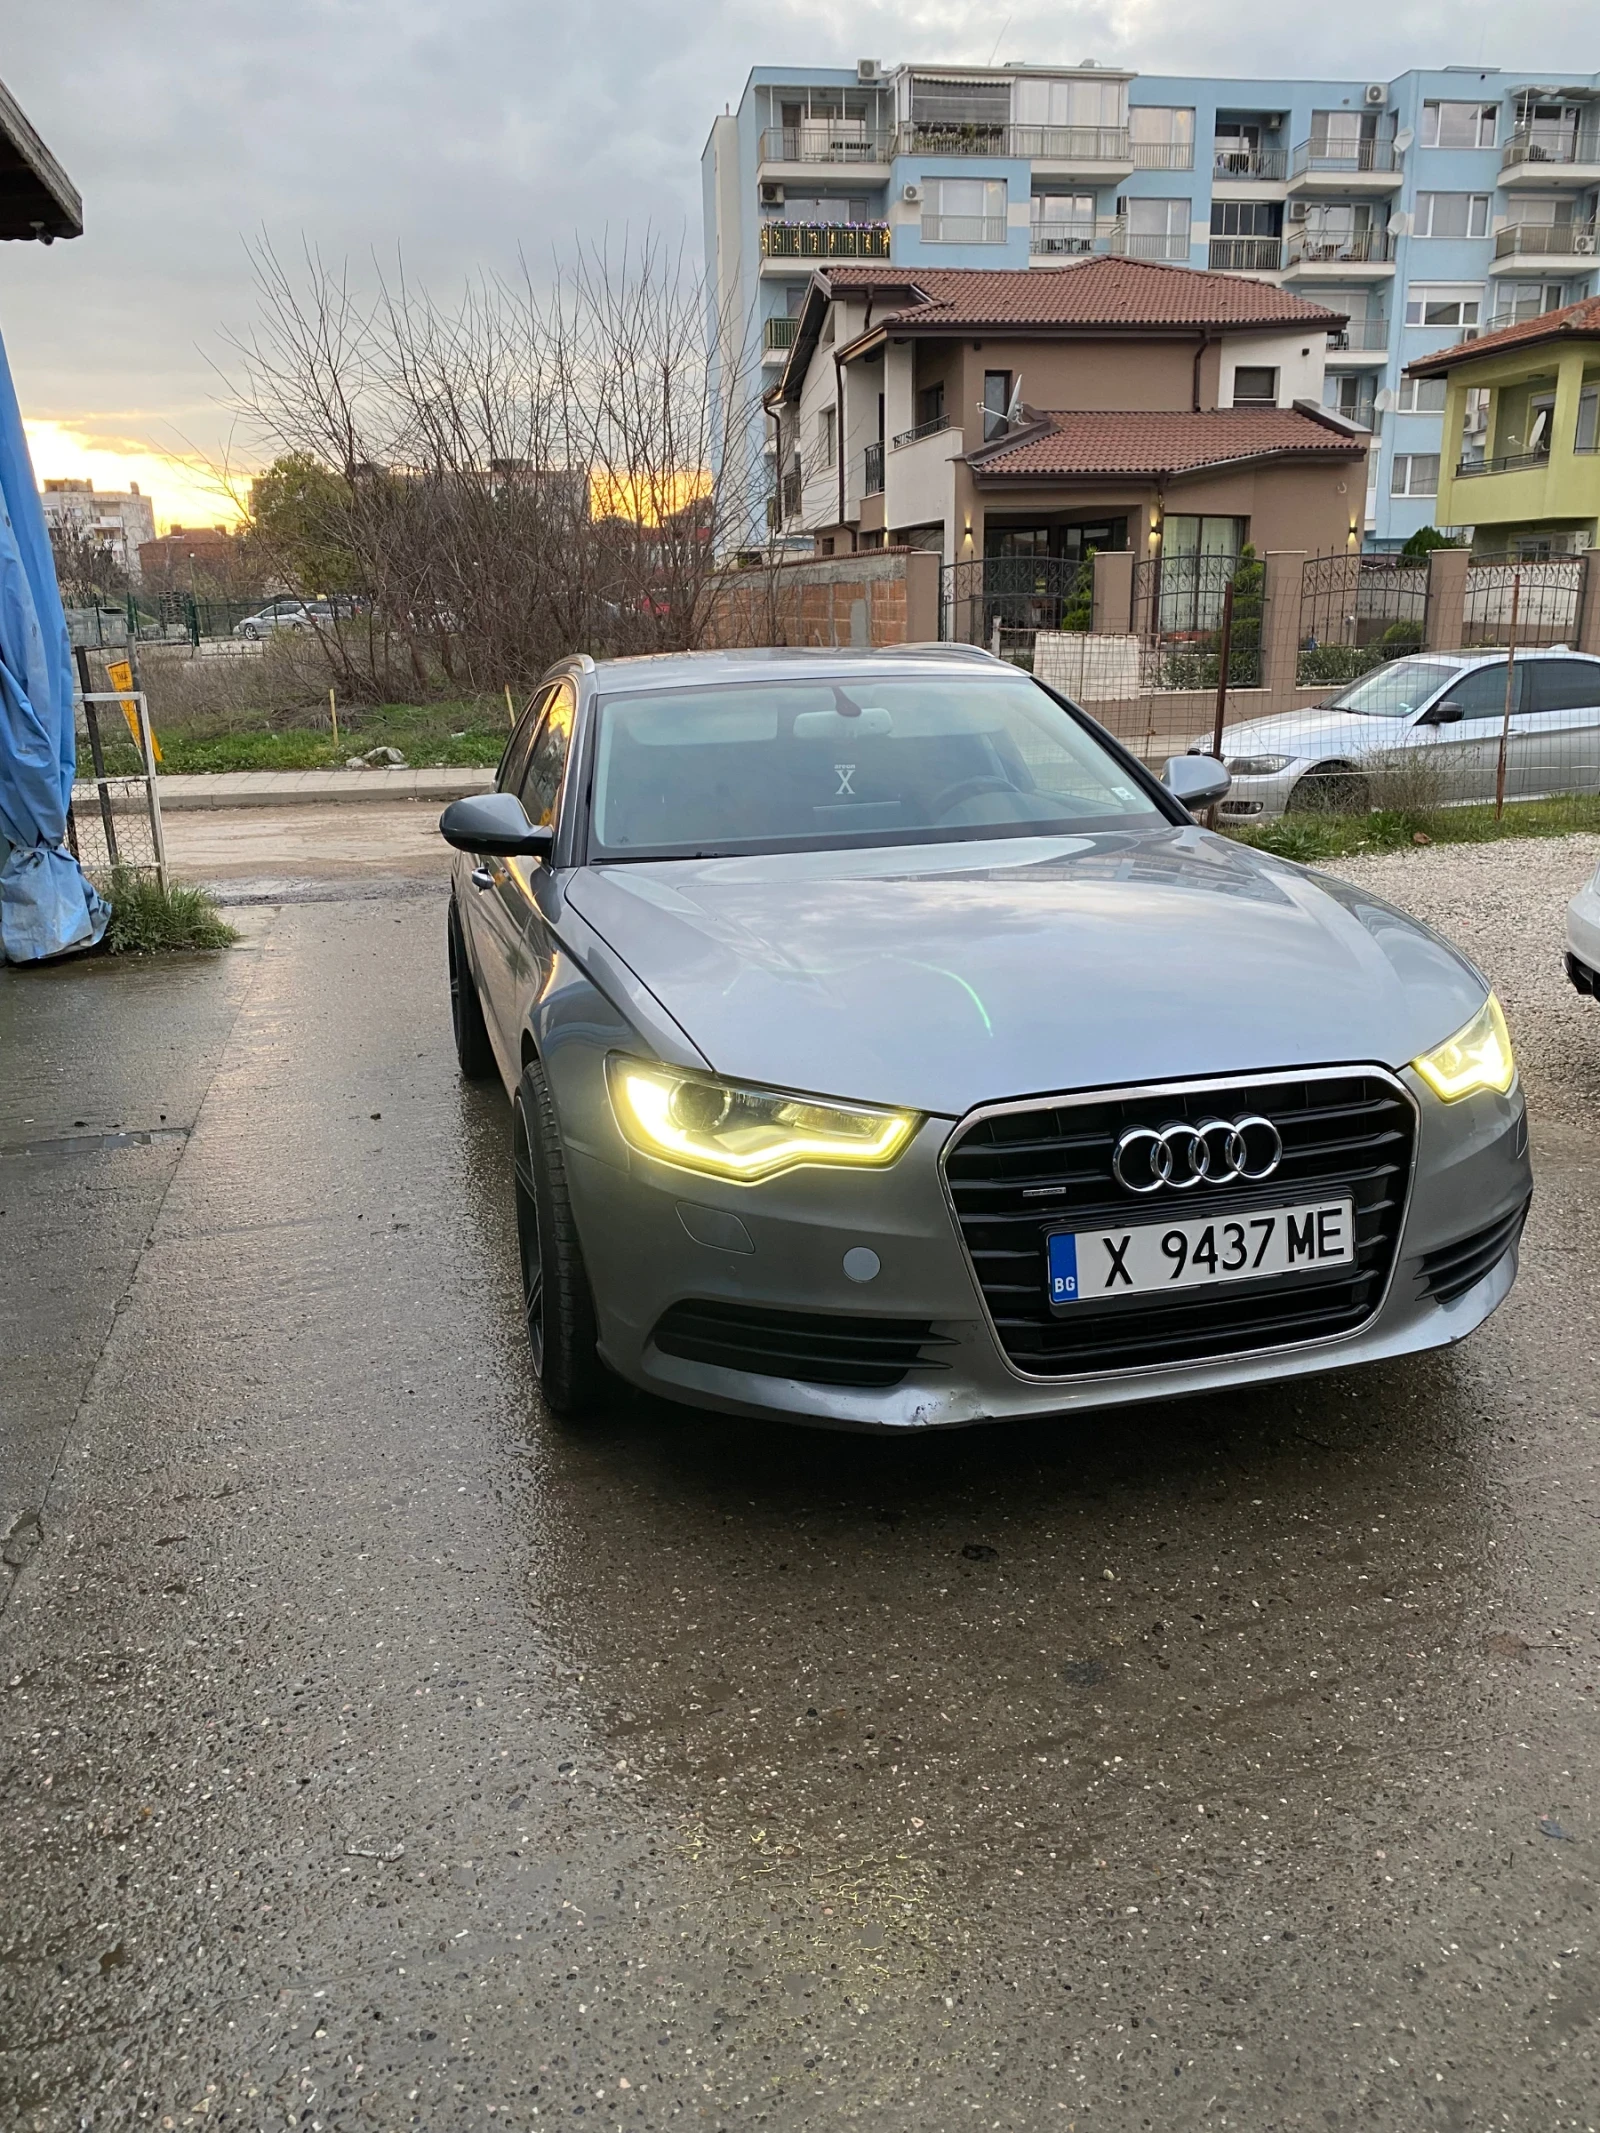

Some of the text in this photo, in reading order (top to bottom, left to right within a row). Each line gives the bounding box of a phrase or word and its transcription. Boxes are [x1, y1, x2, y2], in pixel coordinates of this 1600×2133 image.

[835, 769, 856, 794] X
[1102, 1208, 1345, 1287] X 9437 ME
[1054, 1276, 1076, 1293] BG
